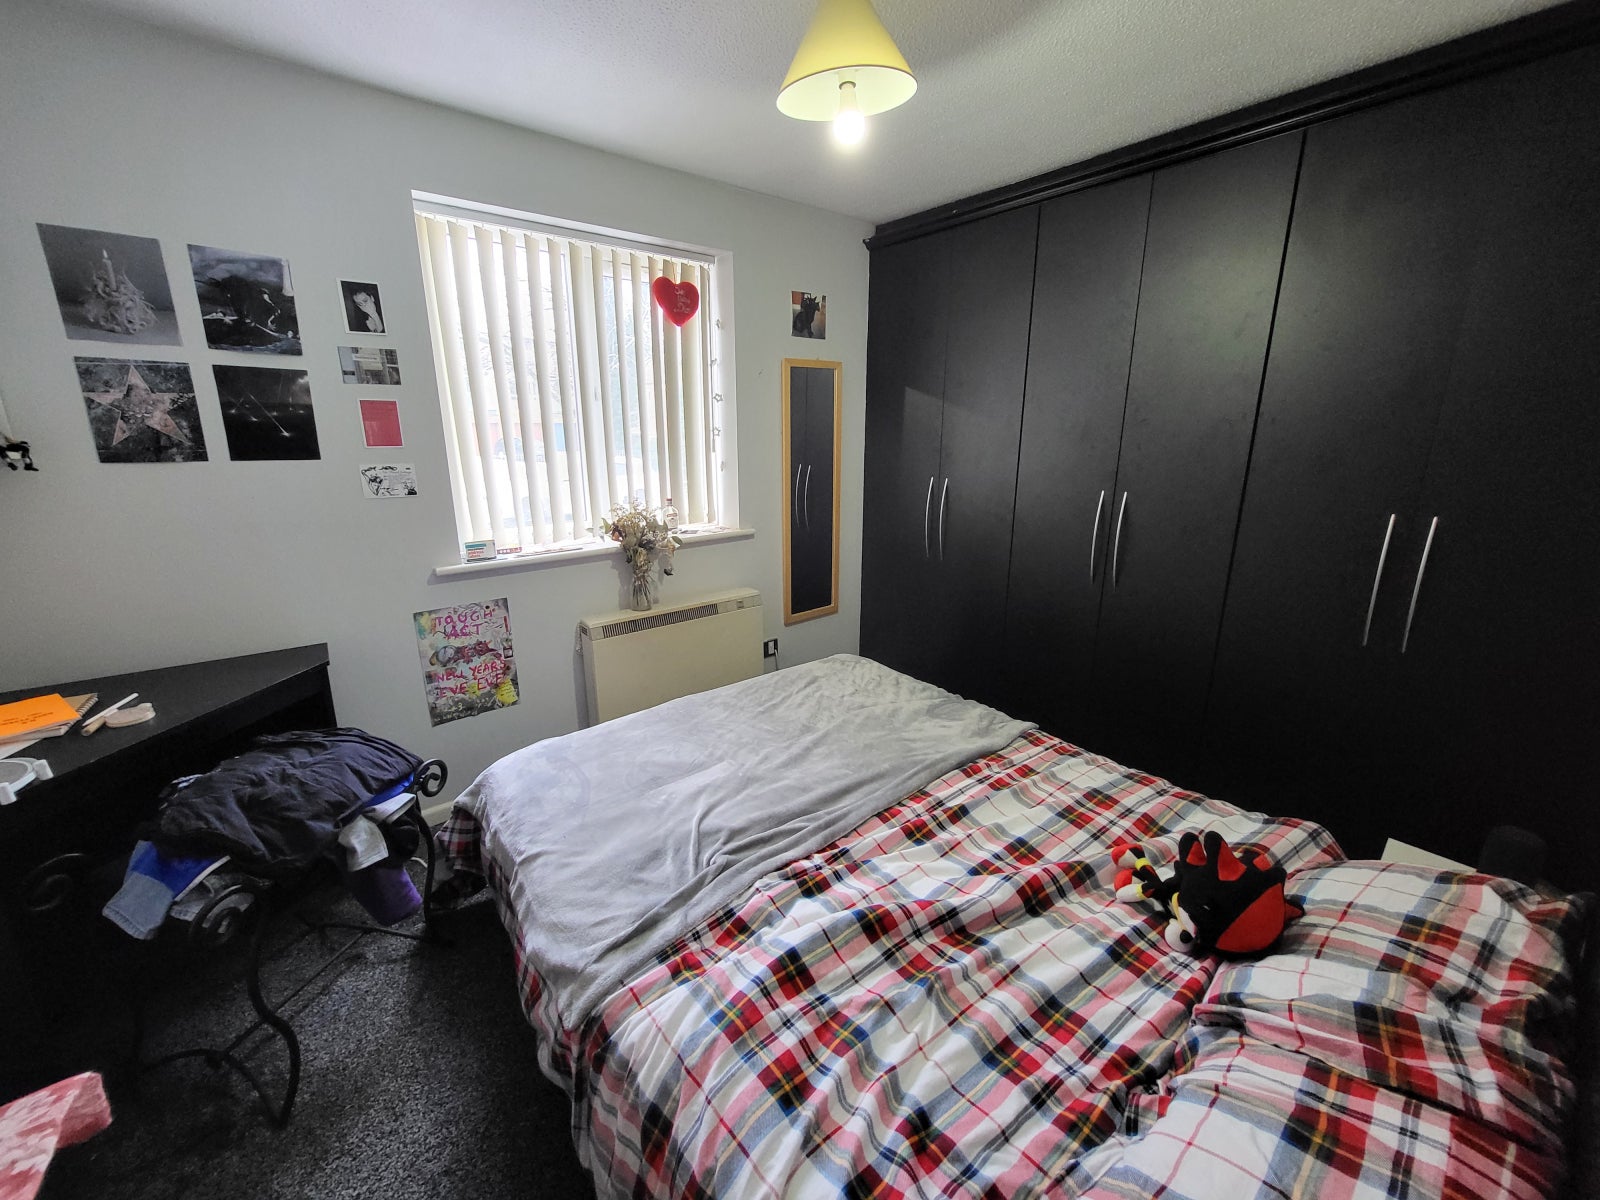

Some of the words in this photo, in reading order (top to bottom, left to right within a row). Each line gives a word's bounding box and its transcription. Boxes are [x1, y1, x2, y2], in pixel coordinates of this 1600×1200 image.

[435, 609, 493, 626] TOUGH
[447, 623, 482, 639] ACT
[436, 669, 464, 683] NEW
[438, 682, 468, 698] EVE
[477, 673, 504, 690] EVE
